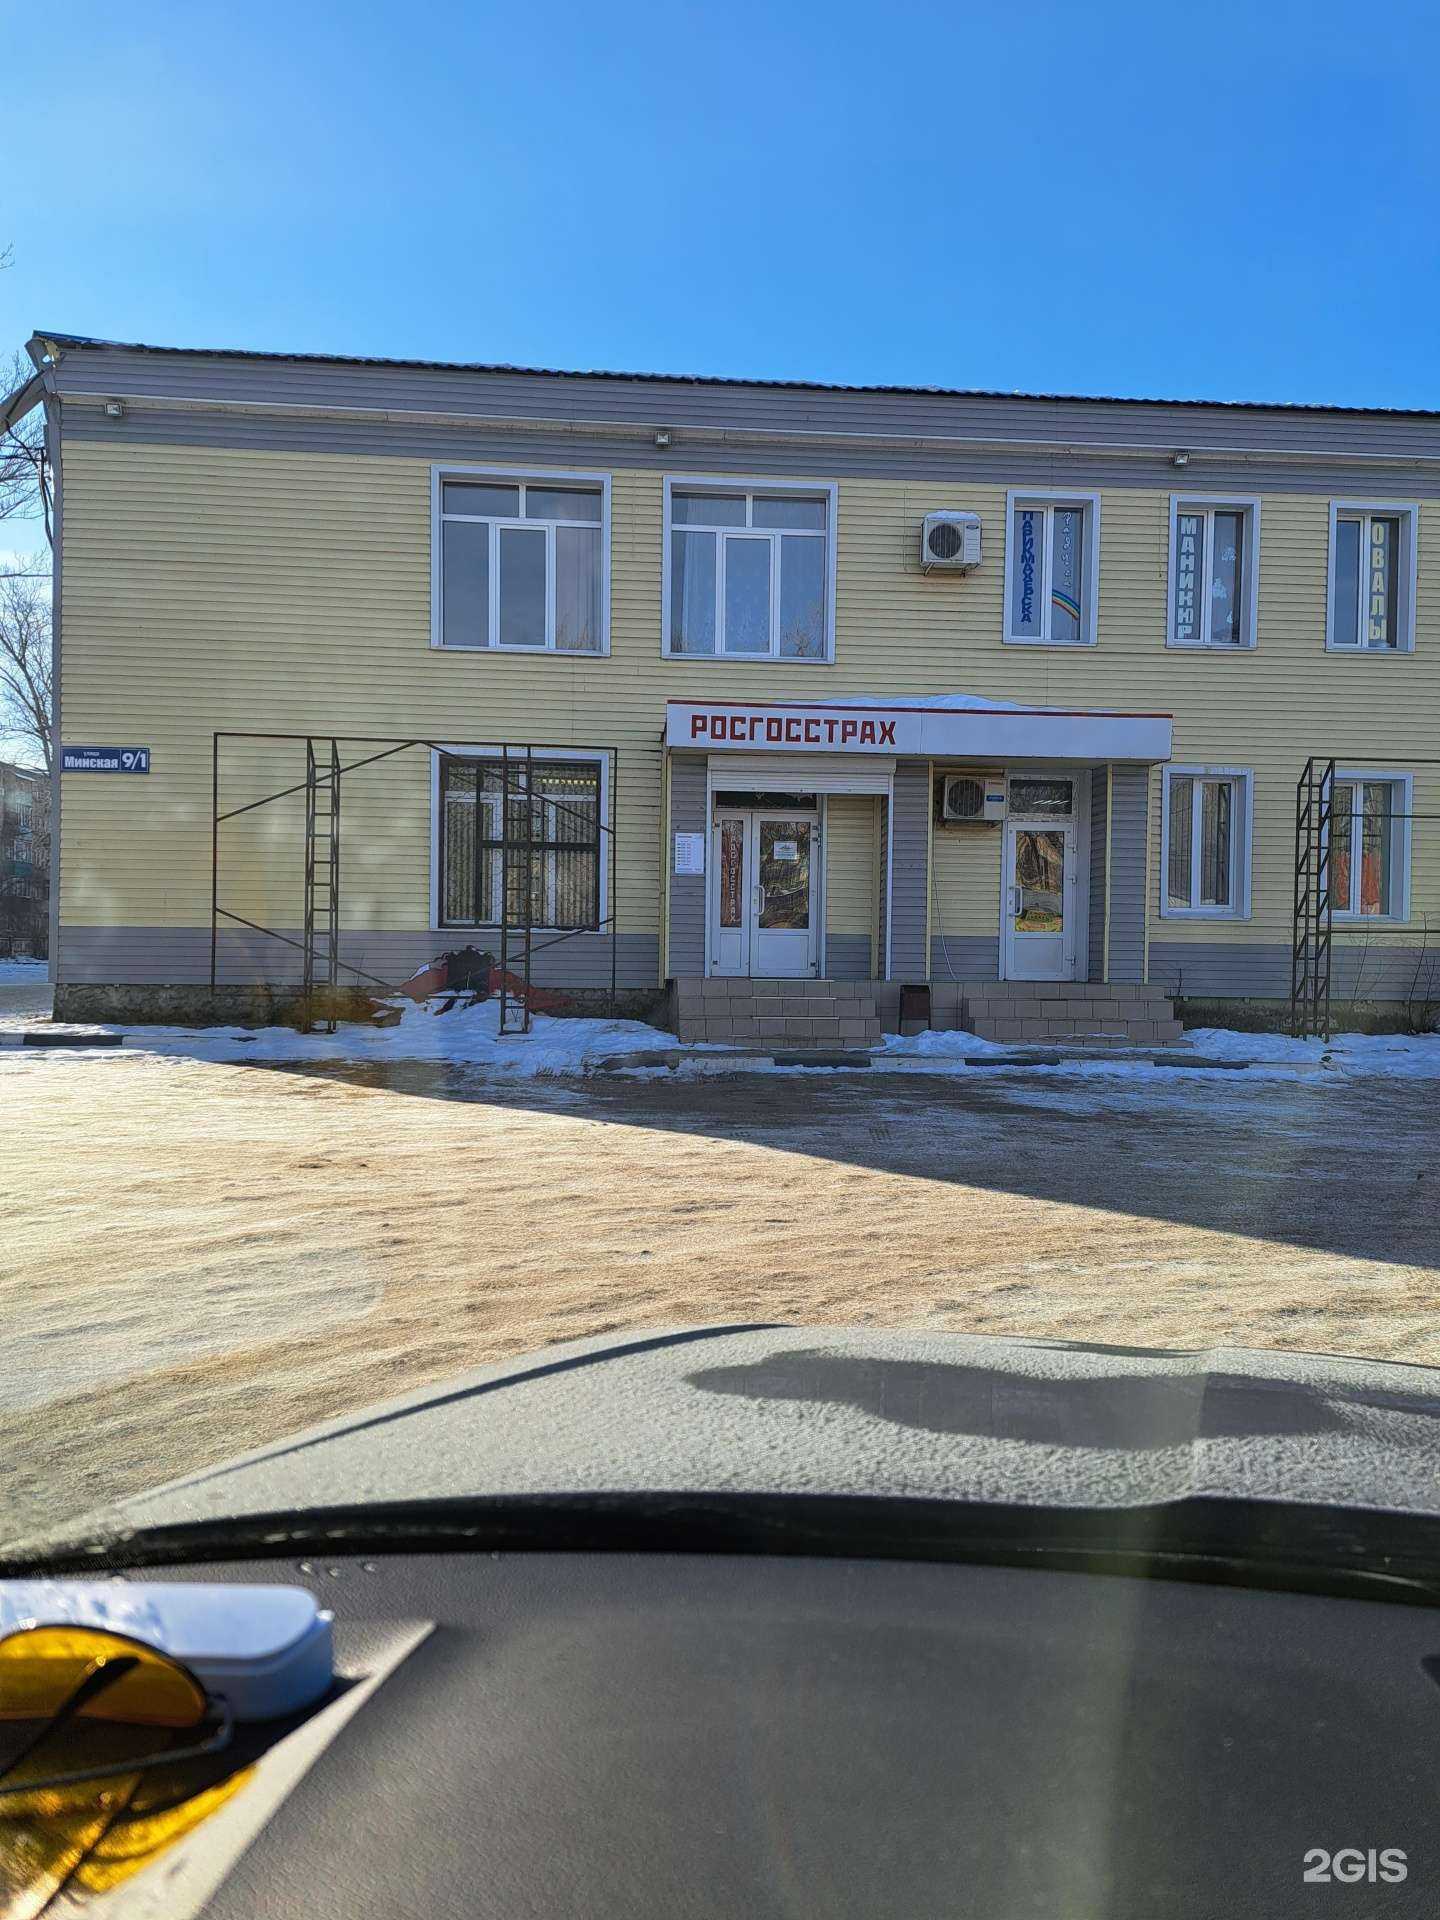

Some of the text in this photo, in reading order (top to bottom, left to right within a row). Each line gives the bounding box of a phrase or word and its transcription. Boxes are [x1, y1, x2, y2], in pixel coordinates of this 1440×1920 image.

[1177, 517, 1197, 639] МАНИКЮР
[1370, 523, 1387, 641] ОВАЛЫ
[64, 751, 147, 770] Минская 9/1
[691, 714, 896, 745] РОСГОССТРАХ
